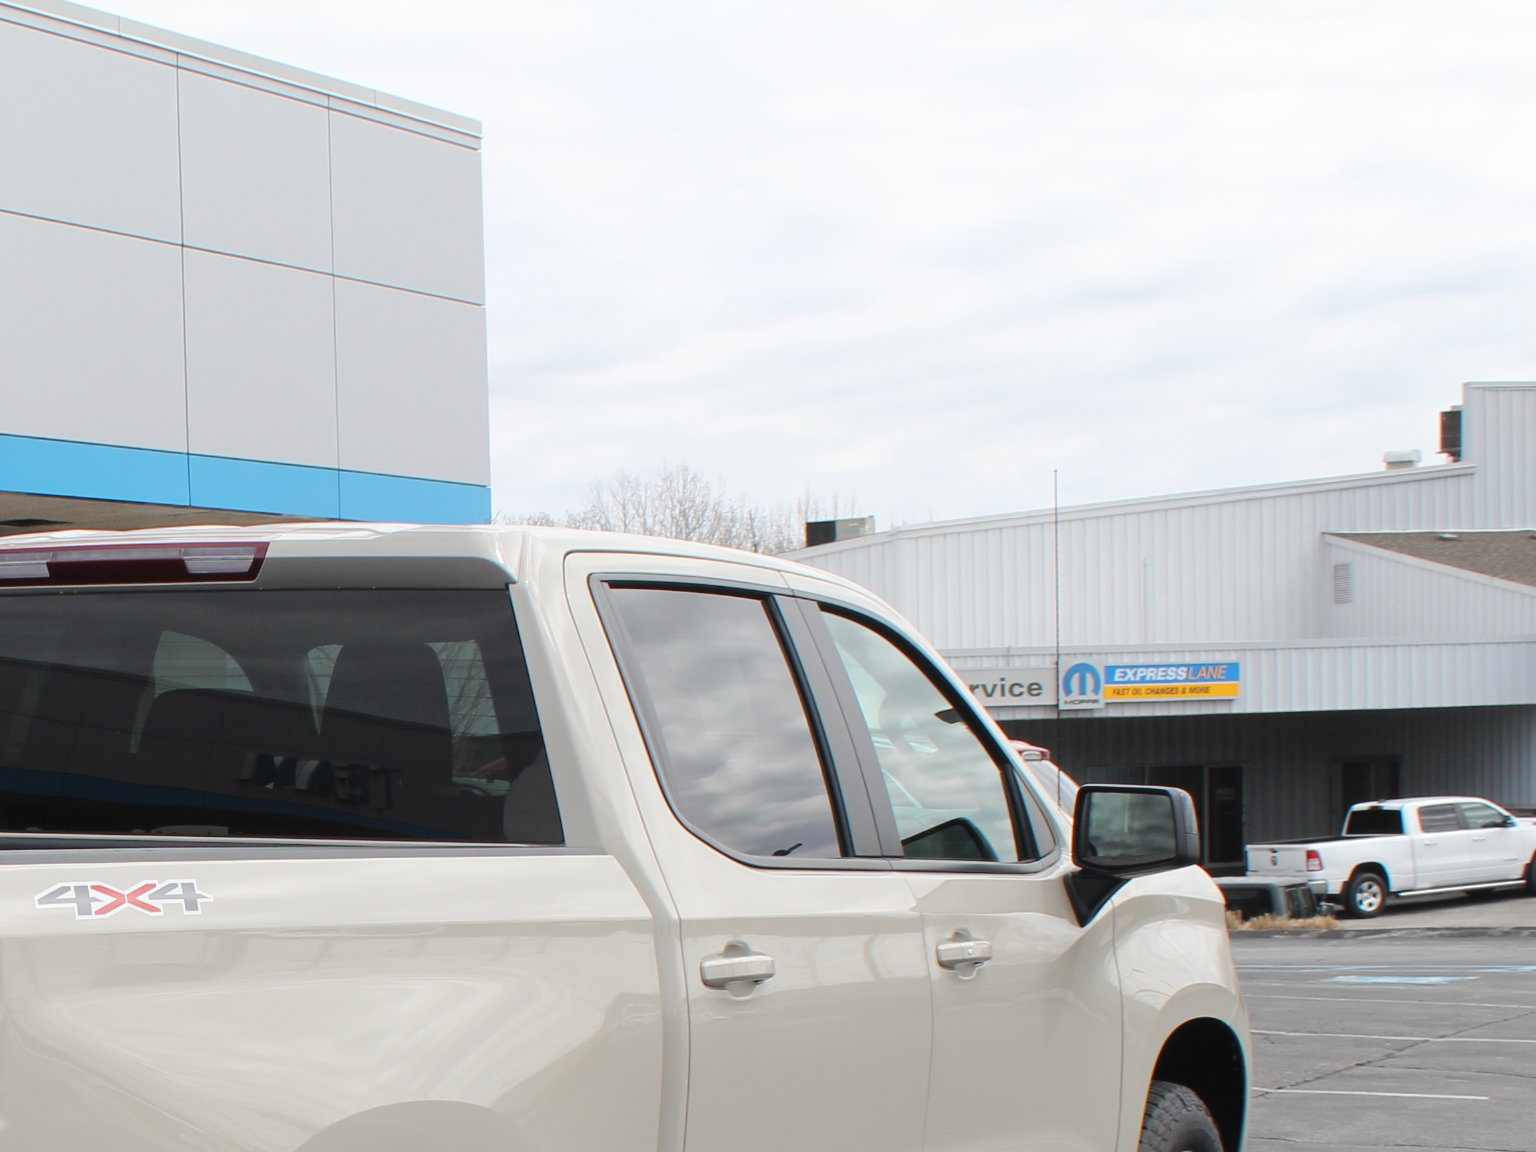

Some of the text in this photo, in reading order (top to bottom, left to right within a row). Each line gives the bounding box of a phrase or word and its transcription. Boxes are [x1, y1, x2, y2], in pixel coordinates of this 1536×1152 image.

[969, 677, 1043, 698] rvice
[1112, 687, 1130, 696] FAST
[1145, 686, 1180, 696] CHANGES
[1188, 685, 1210, 695] MORE
